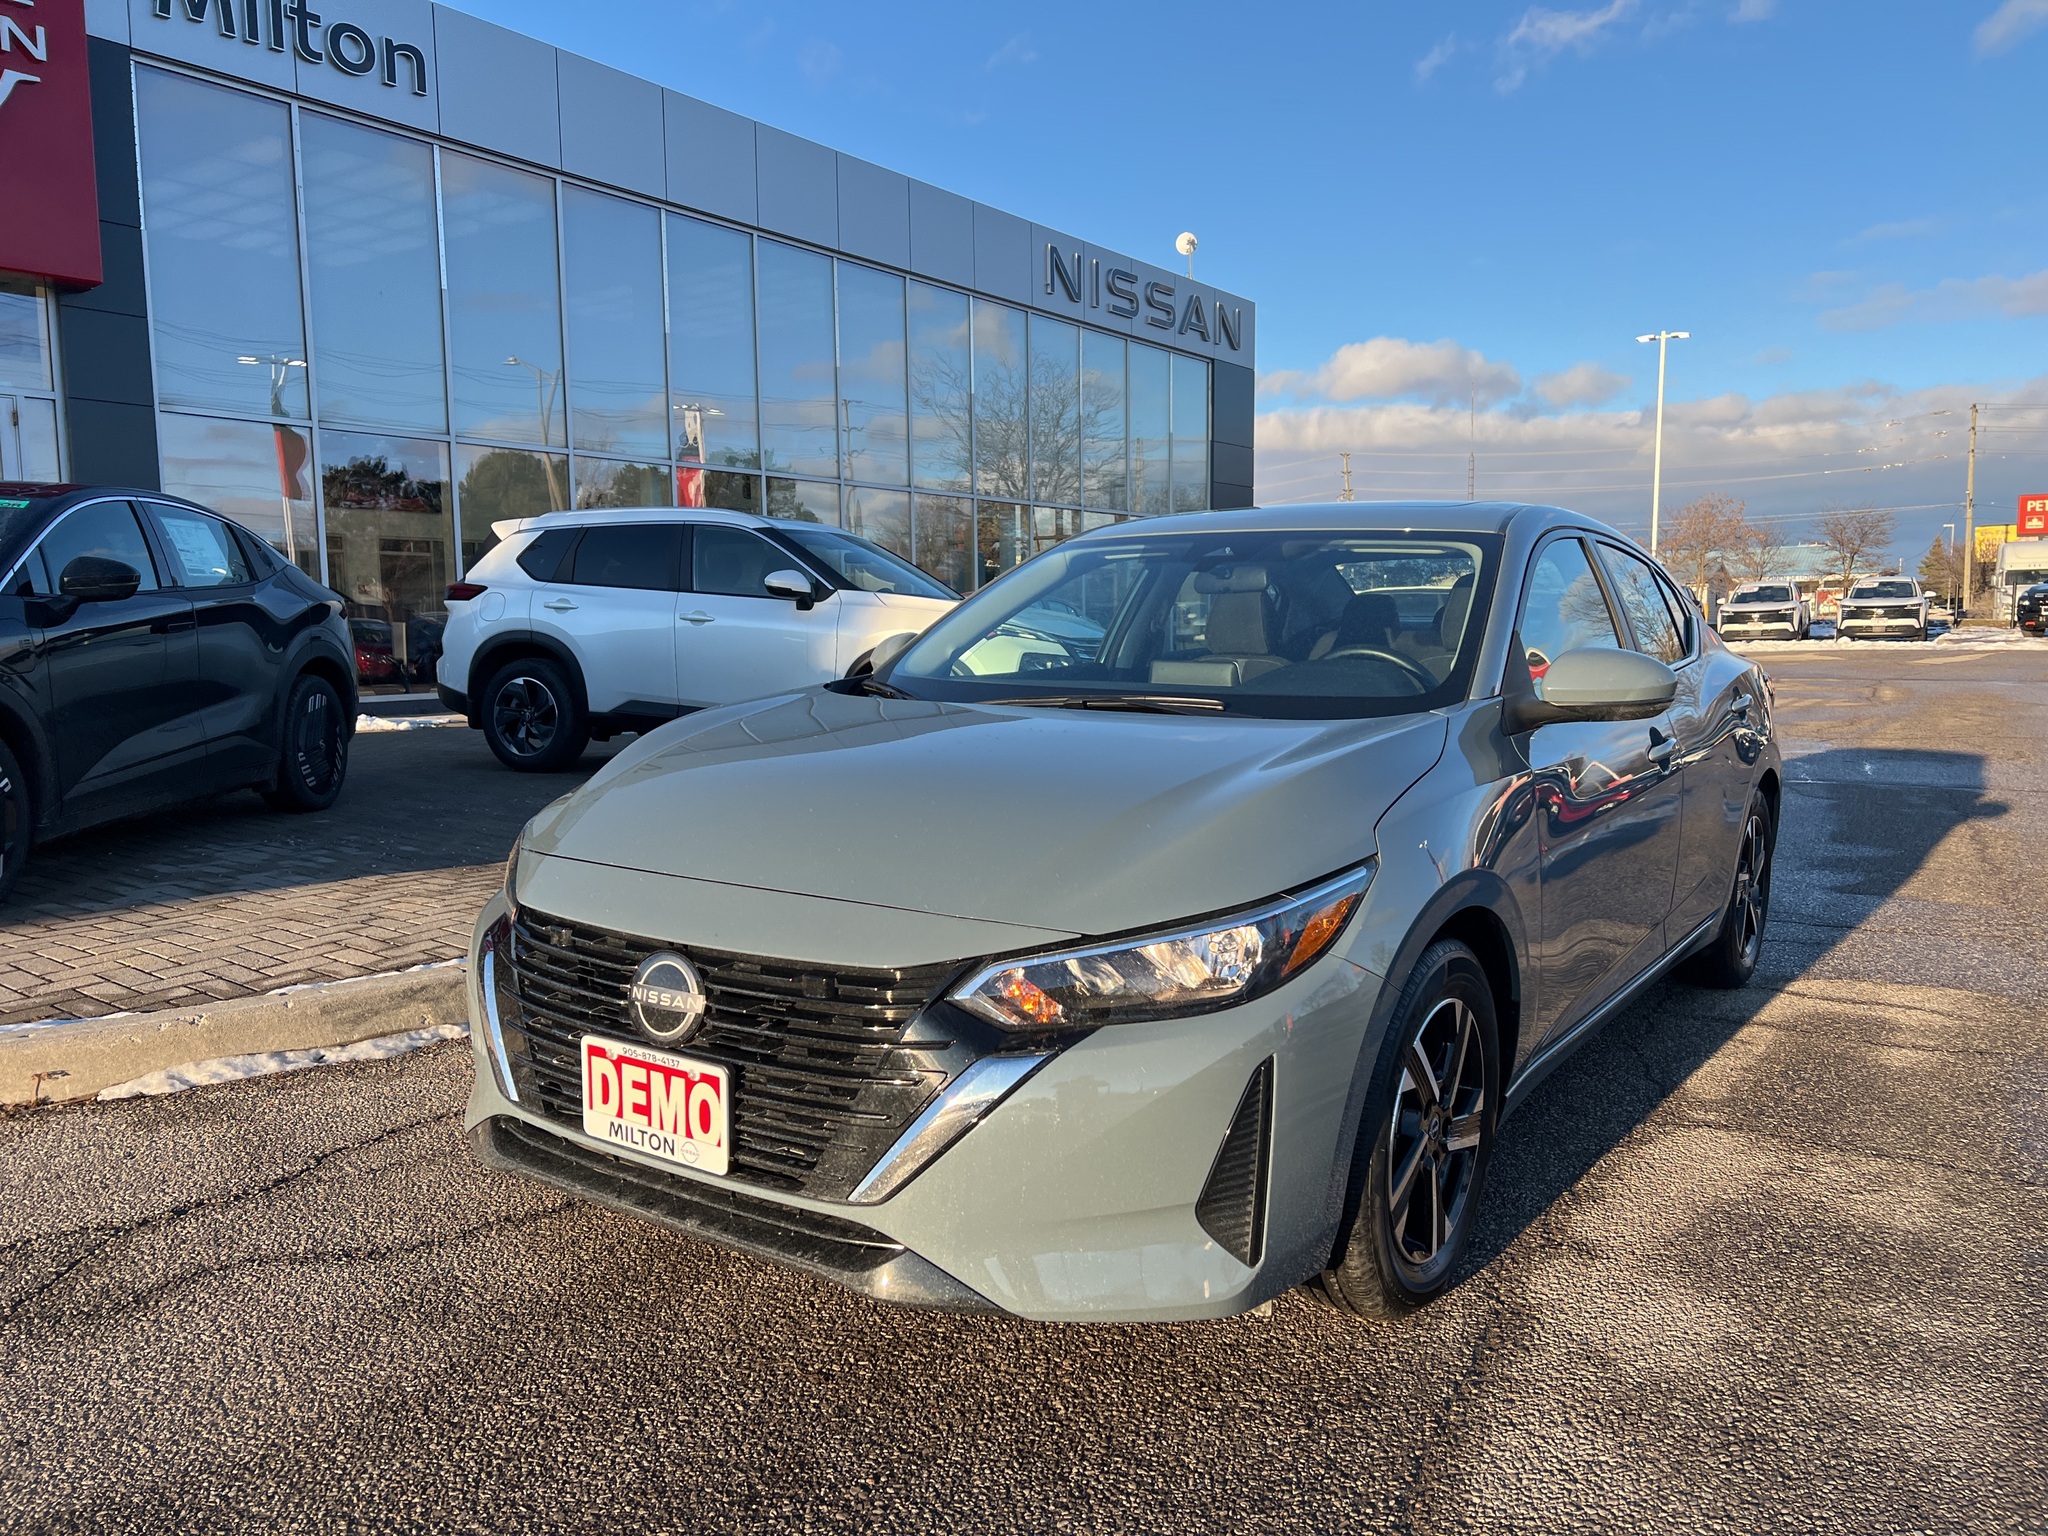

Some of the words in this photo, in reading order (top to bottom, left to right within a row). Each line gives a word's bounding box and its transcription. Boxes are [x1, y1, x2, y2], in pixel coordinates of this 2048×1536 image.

[1045, 243, 1242, 350] NISSAN
[632, 986, 702, 1010] NISSAN
[622, 1047, 680, 1068] 905-878-4137
[590, 1055, 722, 1147] DEMO
[609, 1121, 675, 1156] MILTON
